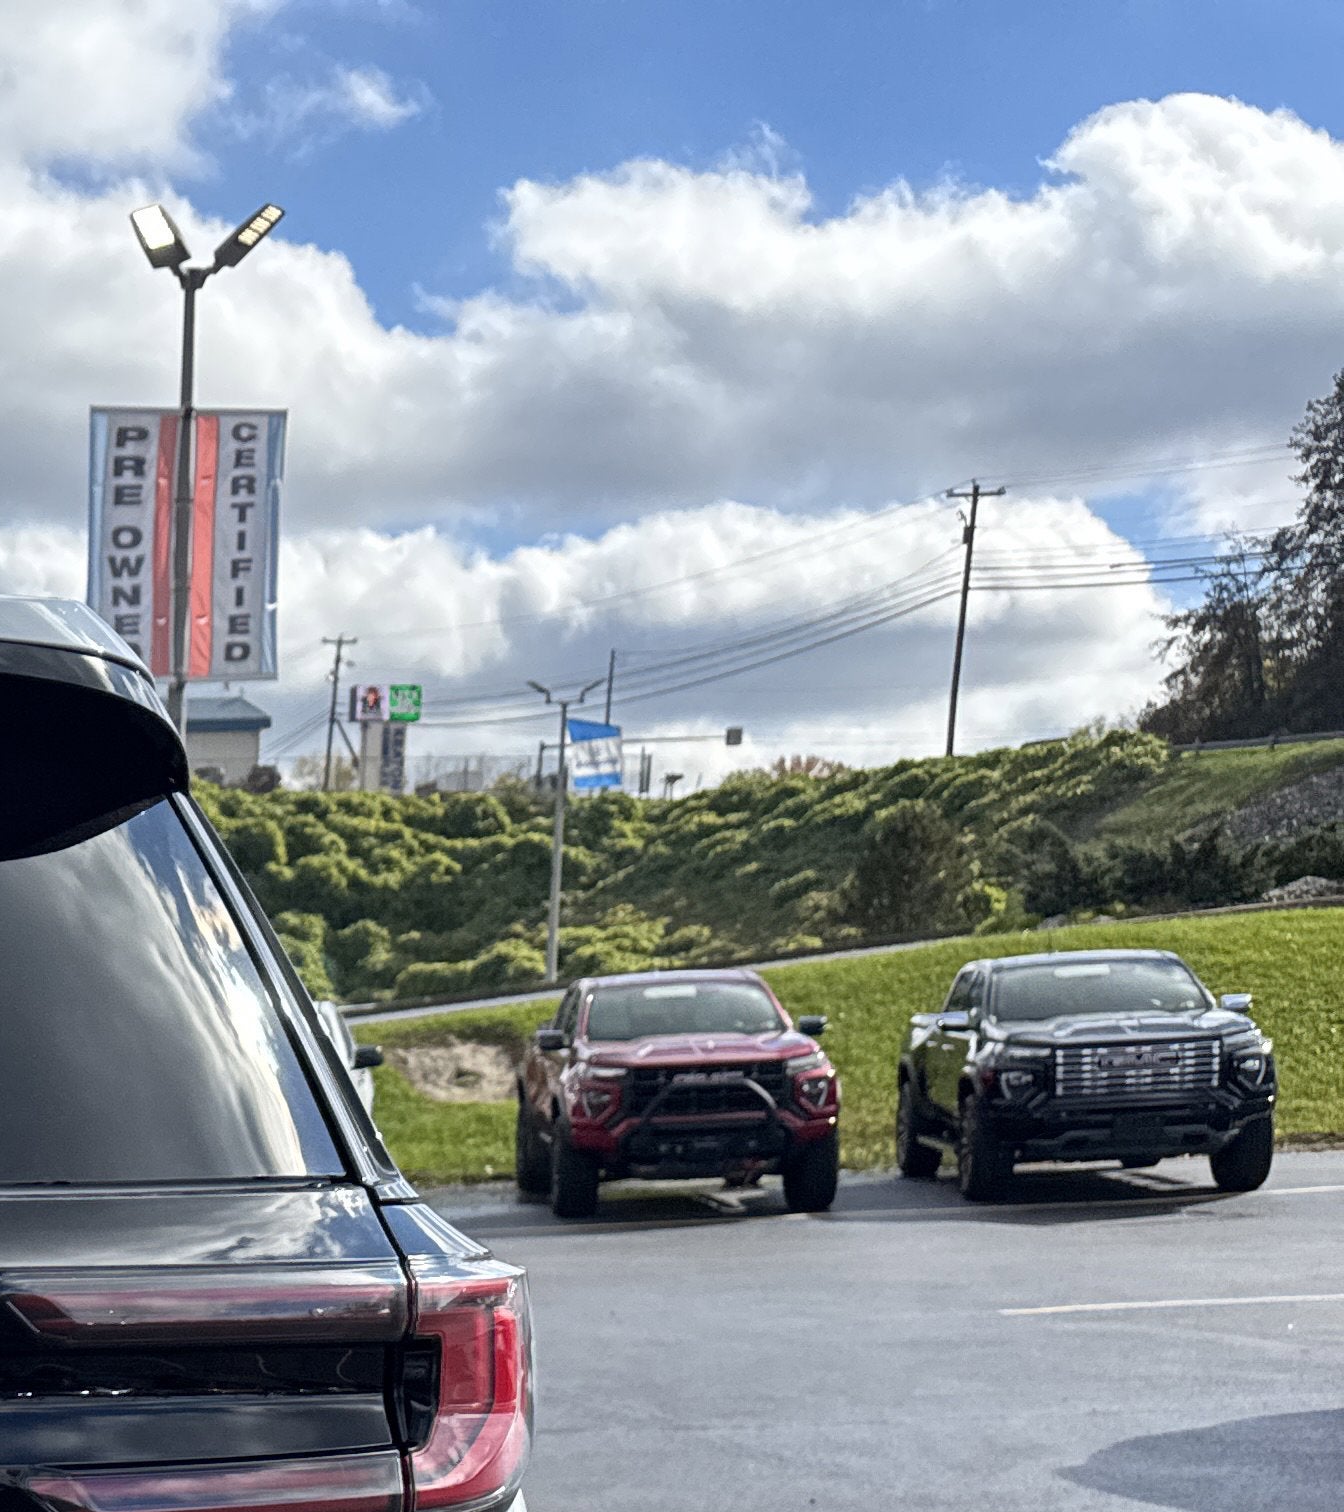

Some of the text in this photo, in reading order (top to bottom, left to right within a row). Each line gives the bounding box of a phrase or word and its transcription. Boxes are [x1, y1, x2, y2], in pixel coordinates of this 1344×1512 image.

[108, 426, 149, 660] PRE OWNE
[223, 421, 258, 662] CERTIFIED
